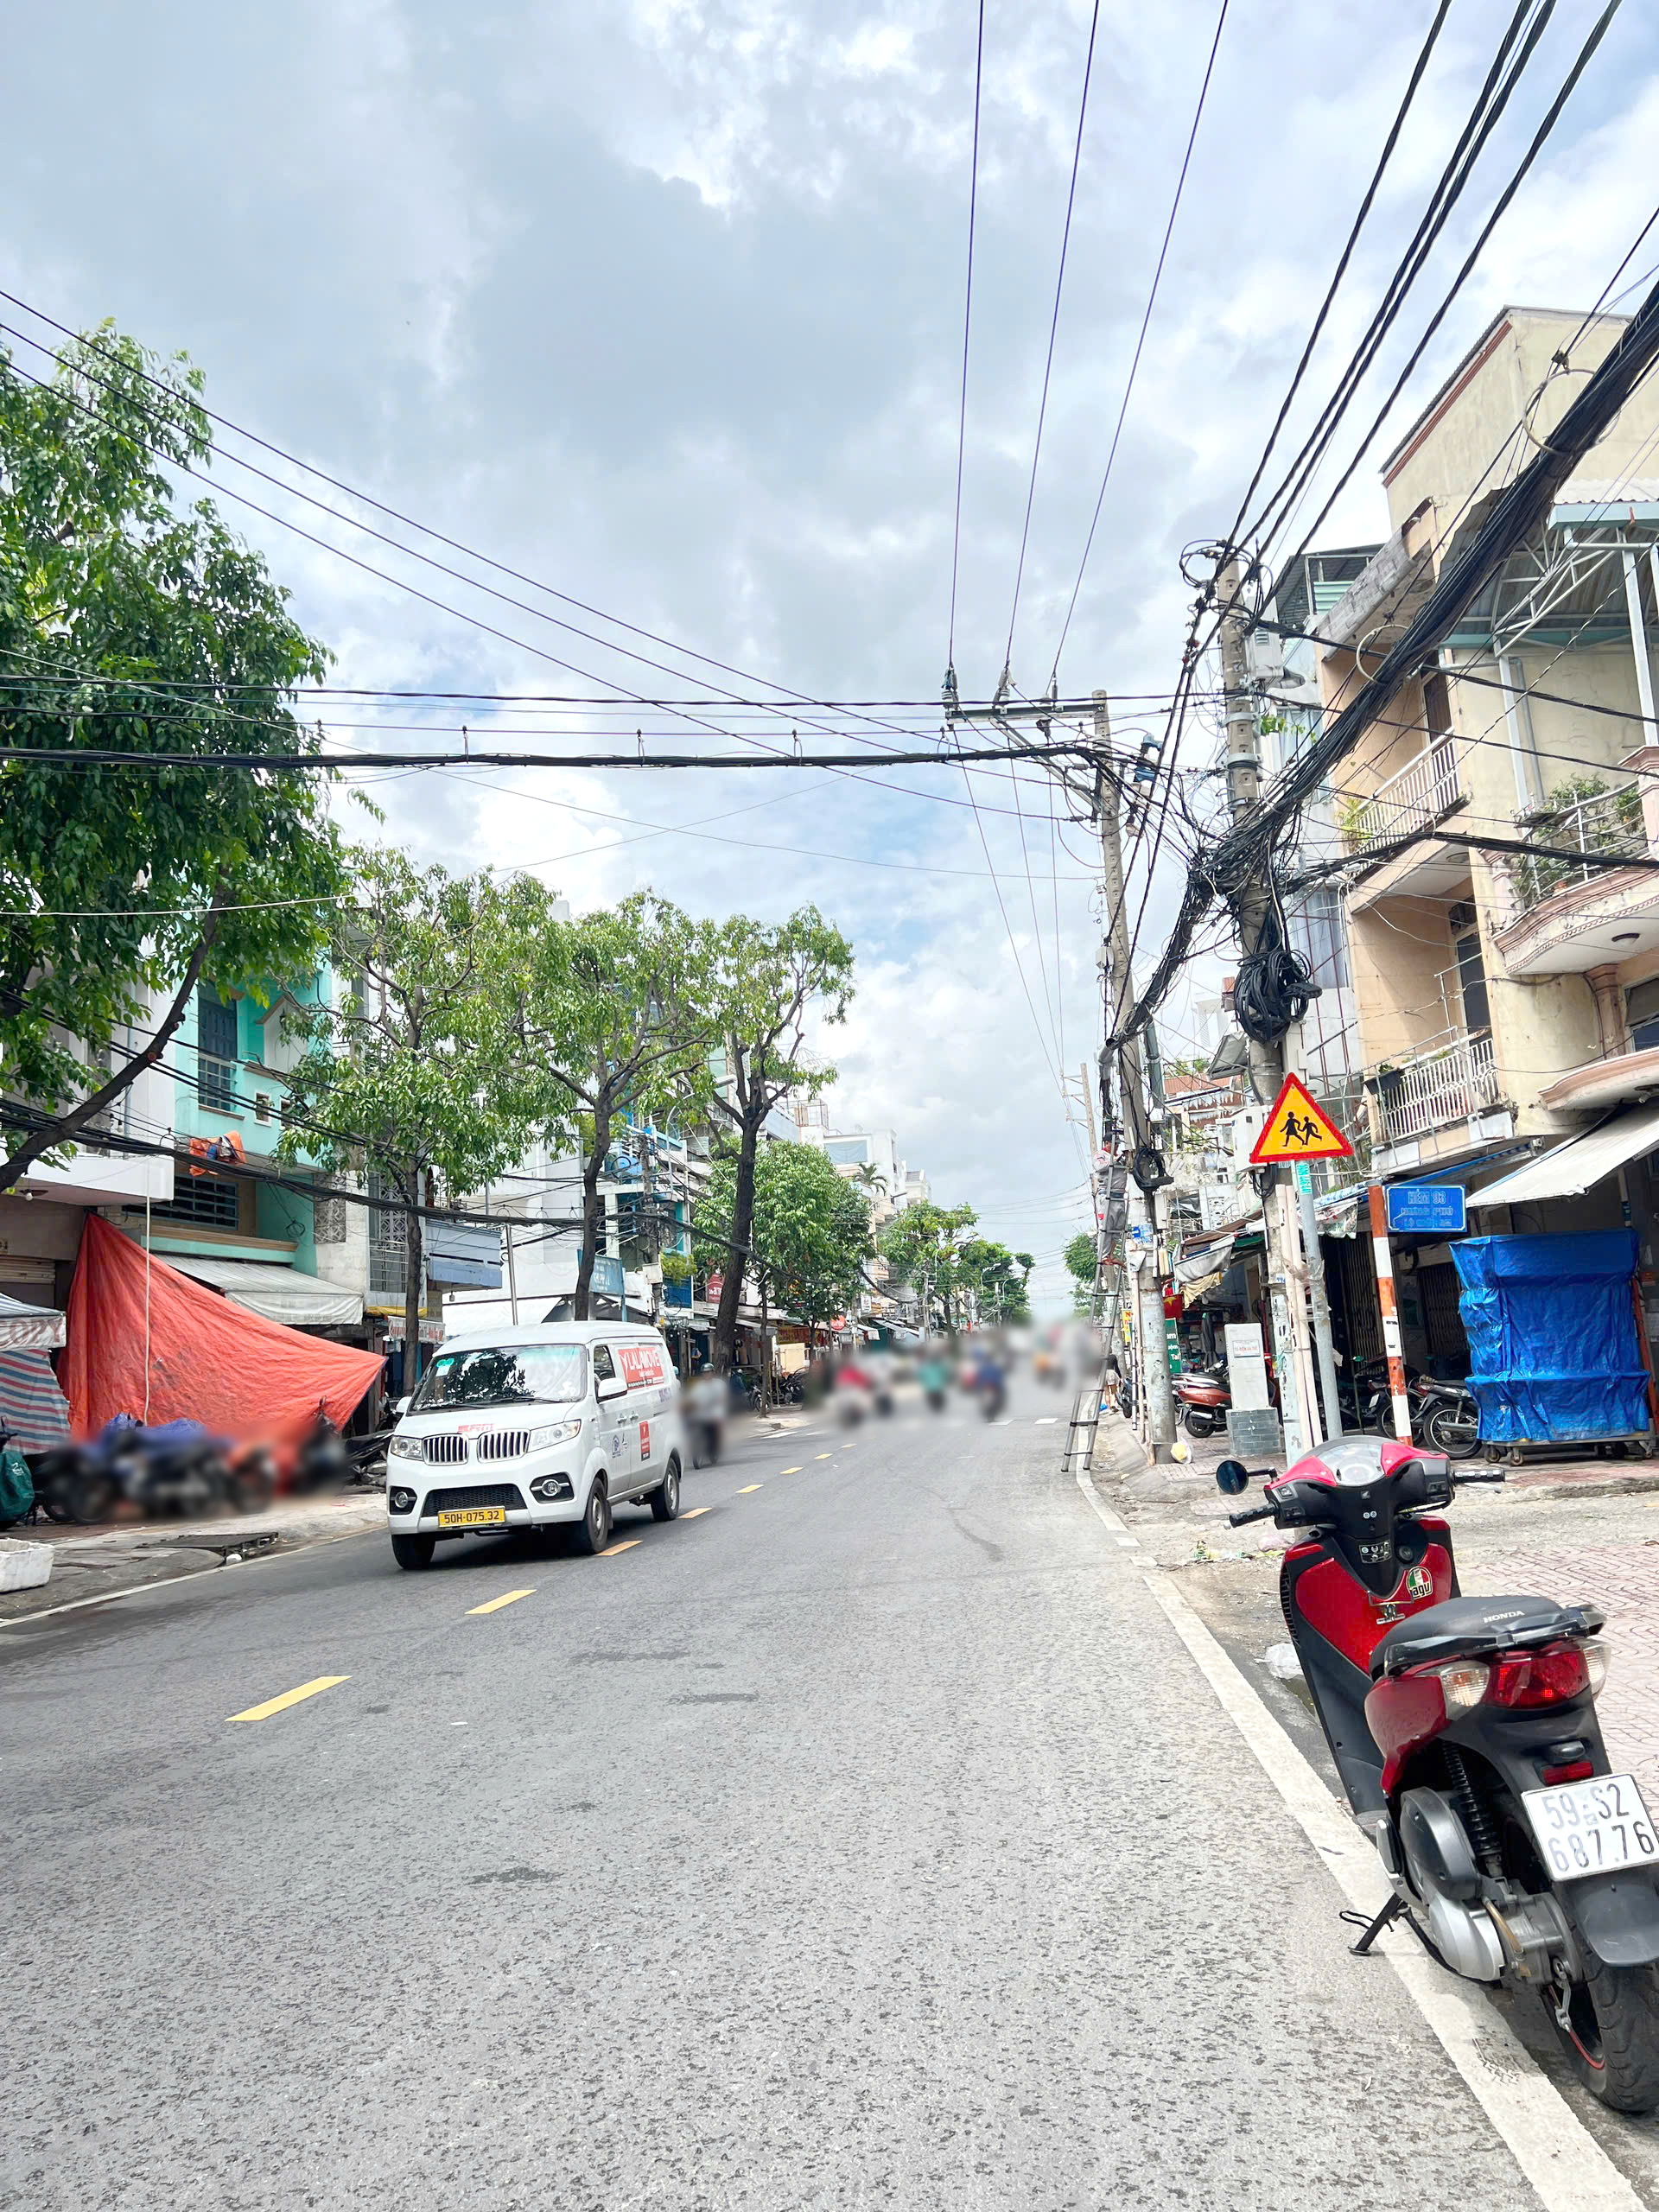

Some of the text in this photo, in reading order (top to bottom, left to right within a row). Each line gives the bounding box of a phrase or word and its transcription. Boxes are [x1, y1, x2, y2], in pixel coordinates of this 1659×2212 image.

[1433, 1192, 1446, 1205] 93
[444, 1510, 499, 1523] 50H-075.32
[1412, 1582, 1431, 1597] agv
[1483, 1610, 1525, 1624] HONDA
